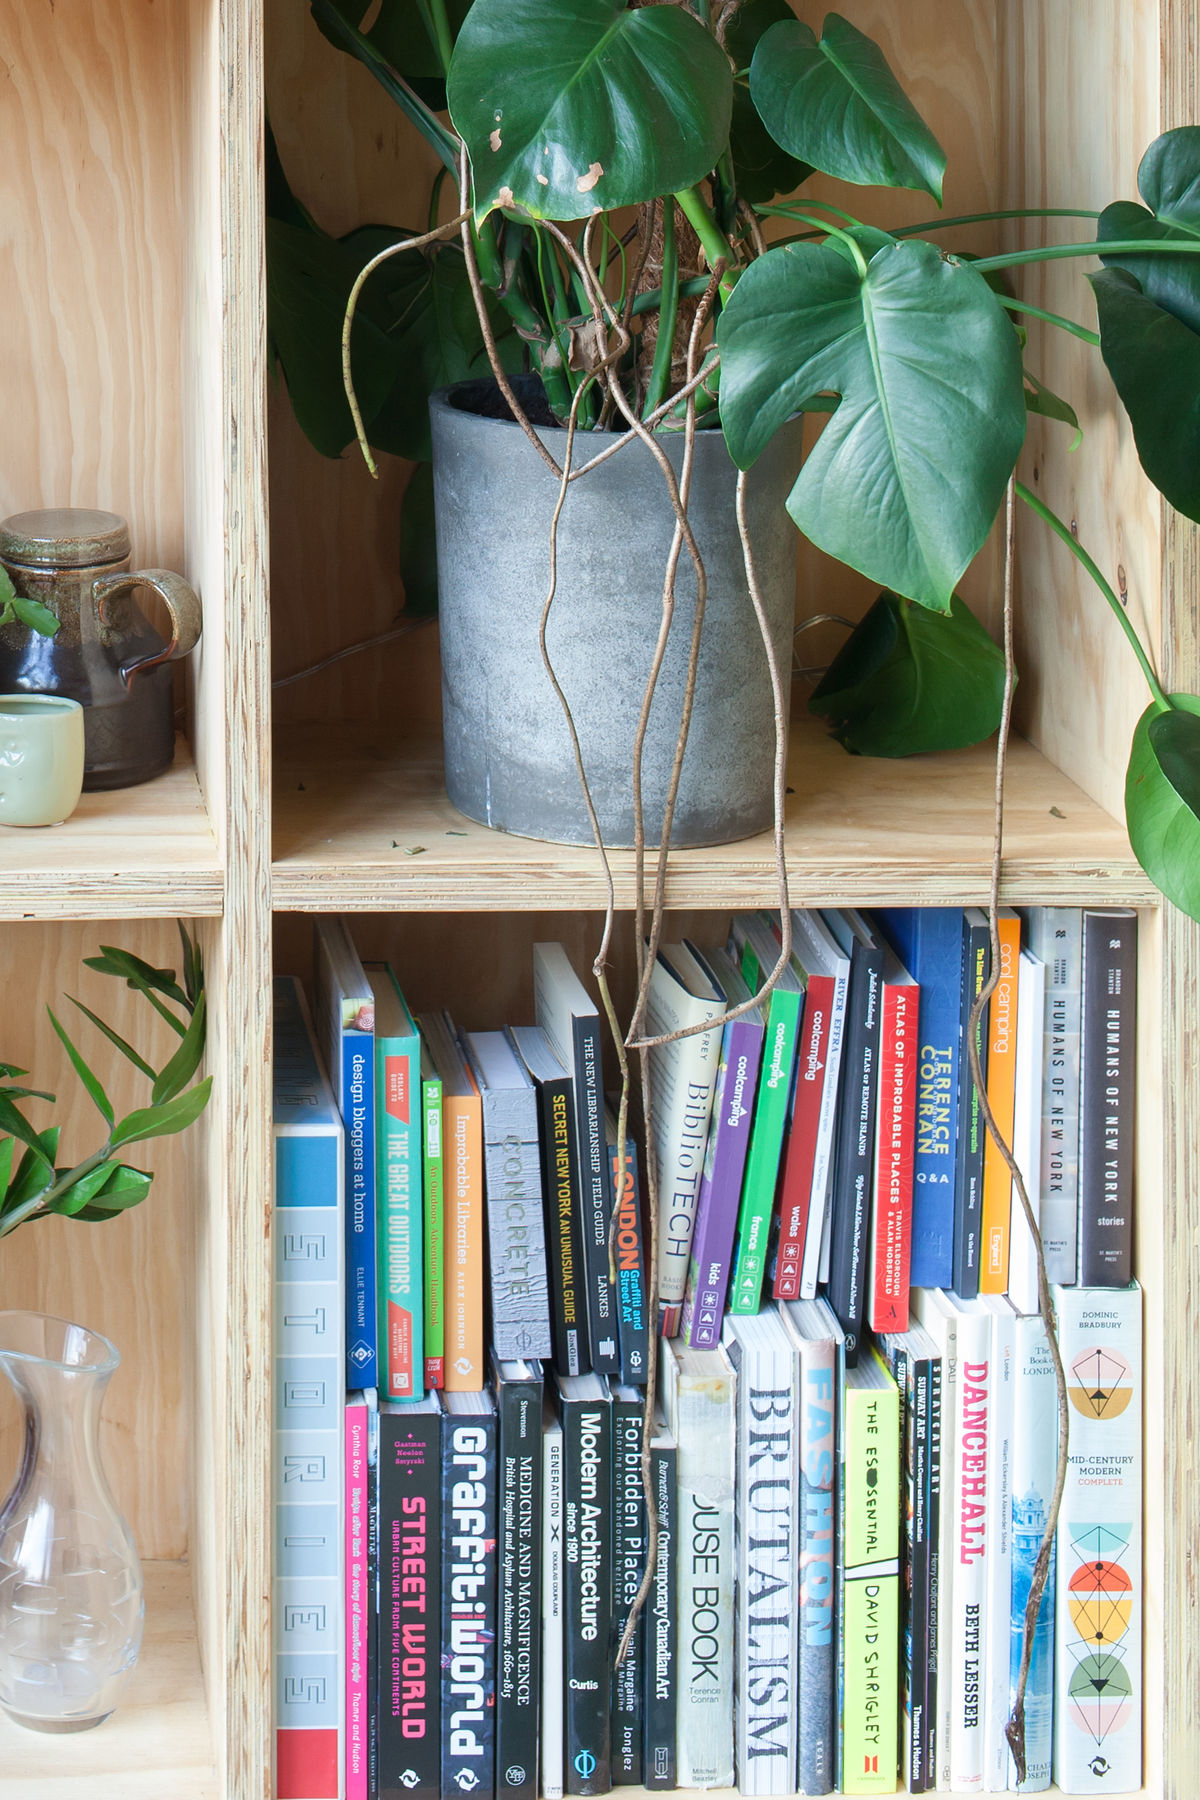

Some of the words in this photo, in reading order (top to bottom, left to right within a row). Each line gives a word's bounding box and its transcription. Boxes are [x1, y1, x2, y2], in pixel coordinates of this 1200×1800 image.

[999, 943, 1014, 978] cool
[835, 978, 847, 1011] RIVER
[1107, 968, 1115, 995] STANTON
[895, 995, 906, 1037] ATLAS
[993, 983, 1013, 1053] camping
[1052, 1001, 1066, 1067] HUMANS
[583, 1037, 594, 1060] THE
[804, 1011, 824, 1081] coolcamping
[831, 1018, 843, 1052] EFFRA
[895, 1042, 905, 1058] OF
[1105, 1010, 1120, 1077] HUMANS
[767, 1022, 786, 1088] coolcamping
[863, 1047, 873, 1073] ATLAS
[350, 1055, 366, 1103] design
[585, 1061, 595, 1088] NEW
[727, 1056, 748, 1127] coolcamping
[1051, 1078, 1065, 1096] OF
[860, 1085, 870, 1120] REMOTE
[892, 1063, 903, 1148] IMPROBABLE
[918, 1045, 936, 1153] CONRAN
[934, 1046, 952, 1155] TERENCE
[1105, 1087, 1120, 1106] OF
[351, 1107, 366, 1170] bloggers
[552, 1095, 568, 1146] SECRET
[586, 1090, 600, 1173] LIBRARIANSHIP
[857, 1121, 869, 1156] ISLANDS
[1050, 1107, 1064, 1140] NEW
[1104, 1116, 1119, 1150] NEW
[388, 1131, 409, 1160] THE
[456, 1115, 470, 1198] Improbable
[353, 1174, 366, 1188] at
[430, 1165, 438, 1178] An
[554, 1148, 569, 1180] NEW
[665, 1083, 710, 1257] BiblioTECH
[890, 1153, 901, 1204] PLACES
[916, 1172, 926, 1183] Q
[928, 1173, 937, 1183] &
[939, 1173, 949, 1183] A
[1049, 1151, 1063, 1192] YORK
[1103, 1160, 1118, 1203] YORK
[388, 1163, 409, 1210] GREAT
[430, 1181, 438, 1224] Outdoors
[557, 1181, 572, 1217] YORK
[591, 1177, 603, 1209] FIELD
[354, 1192, 367, 1233] home
[502, 1136, 530, 1296] CONCRETE
[560, 1219, 571, 1234] AN
[593, 1212, 604, 1246] GUIDE
[613, 1157, 641, 1270] LONDON
[789, 1206, 801, 1237] wales
[894, 1210, 902, 1240] TRAVIS
[1097, 1216, 1126, 1226] stories
[456, 1201, 470, 1265] Libraries
[748, 1215, 763, 1251] france
[886, 1220, 894, 1243] ALAN
[388, 1215, 410, 1294] OUTDOORS
[430, 1228, 438, 1275] Adventure
[560, 1237, 574, 1288] UNUSUAL
[991, 1234, 1001, 1267] England
[356, 1267, 365, 1288] ELLIE
[457, 1272, 465, 1298] ALEX
[620, 1270, 631, 1304] Street
[707, 1262, 722, 1286] kids
[885, 1246, 894, 1295] HORSFIELD
[893, 1243, 902, 1296] ELBOROUGH
[430, 1279, 439, 1328] Handbook
[597, 1275, 609, 1318] LANKES
[630, 1270, 642, 1307] Graffiti
[356, 1290, 365, 1328] TENNANT
[563, 1290, 576, 1324] GUIDE
[622, 1306, 632, 1323] Art
[632, 1310, 643, 1330] and
[457, 1303, 465, 1350] JOHNSON
[1029, 1357, 1047, 1365] Book
[916, 1376, 926, 1417] SUBWAY
[931, 1366, 941, 1452] SPRAYCAN
[519, 1400, 529, 1438] Stevenson
[867, 1401, 878, 1435] THE
[917, 1417, 926, 1440] ART
[352, 1425, 362, 1457] Cynthia
[580, 1413, 602, 1499] Modern
[615, 1417, 624, 1468] Exploring
[284, 1233, 326, 1704] STORIES
[352, 1459, 362, 1478] Rose
[505, 1457, 516, 1488] British
[624, 1416, 646, 1528] Forbidden
[916, 1467, 924, 1488] Cooper
[960, 1361, 989, 1565] DANCEHALL
[1066, 1456, 1134, 1464] MID-CENTURY
[1079, 1467, 1122, 1475] MODERN
[550, 1446, 560, 1517] GENERATION
[931, 1464, 941, 1494] ART
[502, 1490, 516, 1530] Hospital
[519, 1456, 533, 1539] MEDICINE
[806, 1367, 832, 1646] FASHION
[567, 1502, 578, 1533] since
[616, 1496, 624, 1555] abandoned
[392, 1520, 400, 1553] URBAN
[504, 1531, 515, 1550] and
[567, 1536, 579, 1562] 1900
[1000, 1531, 1008, 1554] Shields
[402, 1497, 426, 1613] STREET
[501, 1551, 515, 1587] Asylum
[518, 1542, 532, 1578] AND
[580, 1502, 602, 1641] Architecture
[624, 1536, 646, 1605] Places
[929, 1552, 938, 1576] Henry
[392, 1556, 400, 1598] CULTURE
[614, 1559, 624, 1605] heritage
[653, 1530, 671, 1618] Contemporary
[748, 1387, 792, 1761] BRUTALISM
[929, 1577, 939, 1609] Chalfant
[392, 1601, 400, 1630] FROM
[865, 1585, 880, 1644] DAVID
[929, 1610, 938, 1624] and
[964, 1603, 980, 1653] BETH
[392, 1632, 400, 1654] FIVE
[517, 1581, 532, 1706] MAGNIFICENCE
[655, 1618, 672, 1679] Canadian
[692, 1586, 720, 1683] BOOK
[929, 1625, 938, 1648] James
[392, 1657, 400, 1716] CONTINENTS
[401, 1623, 426, 1739] WORLD
[569, 1678, 599, 1690] Curtis
[617, 1671, 626, 1712] Margaine
[624, 1660, 637, 1712] Margaine
[656, 1678, 671, 1700] Art
[688, 1687, 721, 1695] Terence
[865, 1651, 880, 1745] SHRIGLEY
[964, 1659, 979, 1729] LESSER
[352, 1692, 362, 1722] Thames
[690, 1696, 720, 1704] Conran
[352, 1724, 361, 1741] and
[912, 1705, 922, 1739] Thames
[352, 1743, 362, 1774] Hudson
[621, 1726, 634, 1771] Jonglez
[912, 1747, 922, 1780] Hudson
